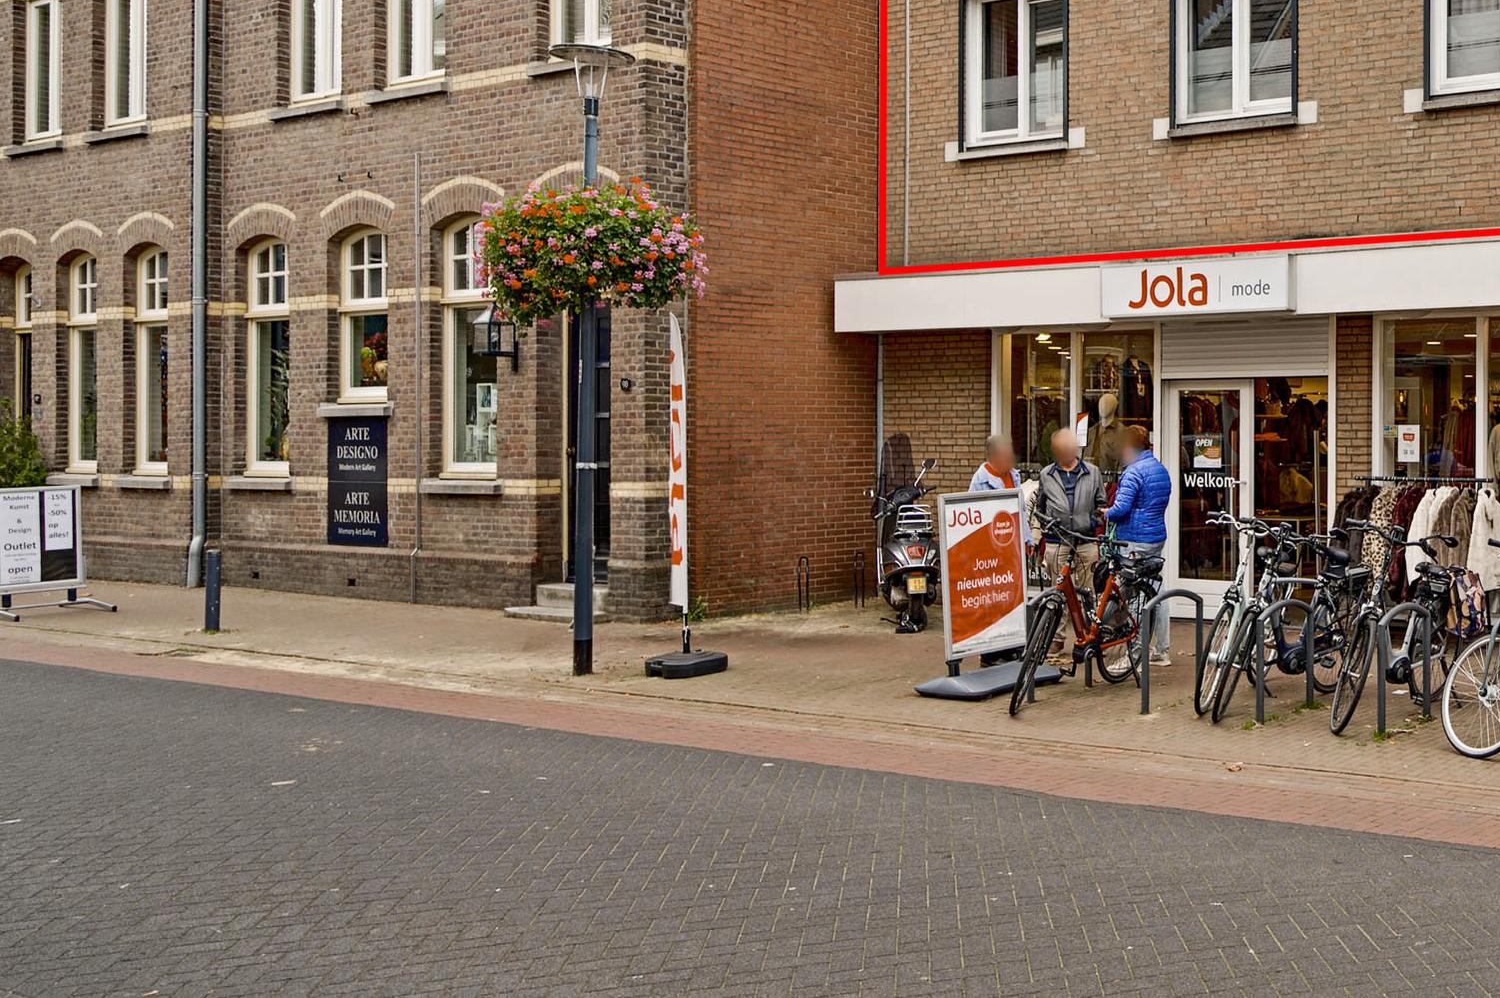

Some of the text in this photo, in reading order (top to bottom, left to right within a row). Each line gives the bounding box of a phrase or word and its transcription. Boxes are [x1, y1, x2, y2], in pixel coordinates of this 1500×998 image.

[1128, 266, 1270, 309] Jola mode
[344, 427, 370, 440] ARTE
[1195, 439, 1213, 447] OPEN
[336, 446, 378, 459] DESIGNO
[338, 463, 354, 471] Modern
[362, 464, 376, 472] Gallery
[1183, 472, 1236, 488] Welkom
[344, 492, 370, 505] ARTE
[334, 510, 380, 524] MEMORIA
[948, 507, 982, 528] Jola
[48, 531, 69, 539] alles!
[362, 528, 376, 537] Gallery
[4, 542, 36, 551] Outlet
[8, 566, 33, 574] open
[973, 558, 998, 571] Jouw
[957, 577, 991, 591] nieuwe
[992, 570, 1014, 585] look
[961, 590, 1010, 608] begint hier
